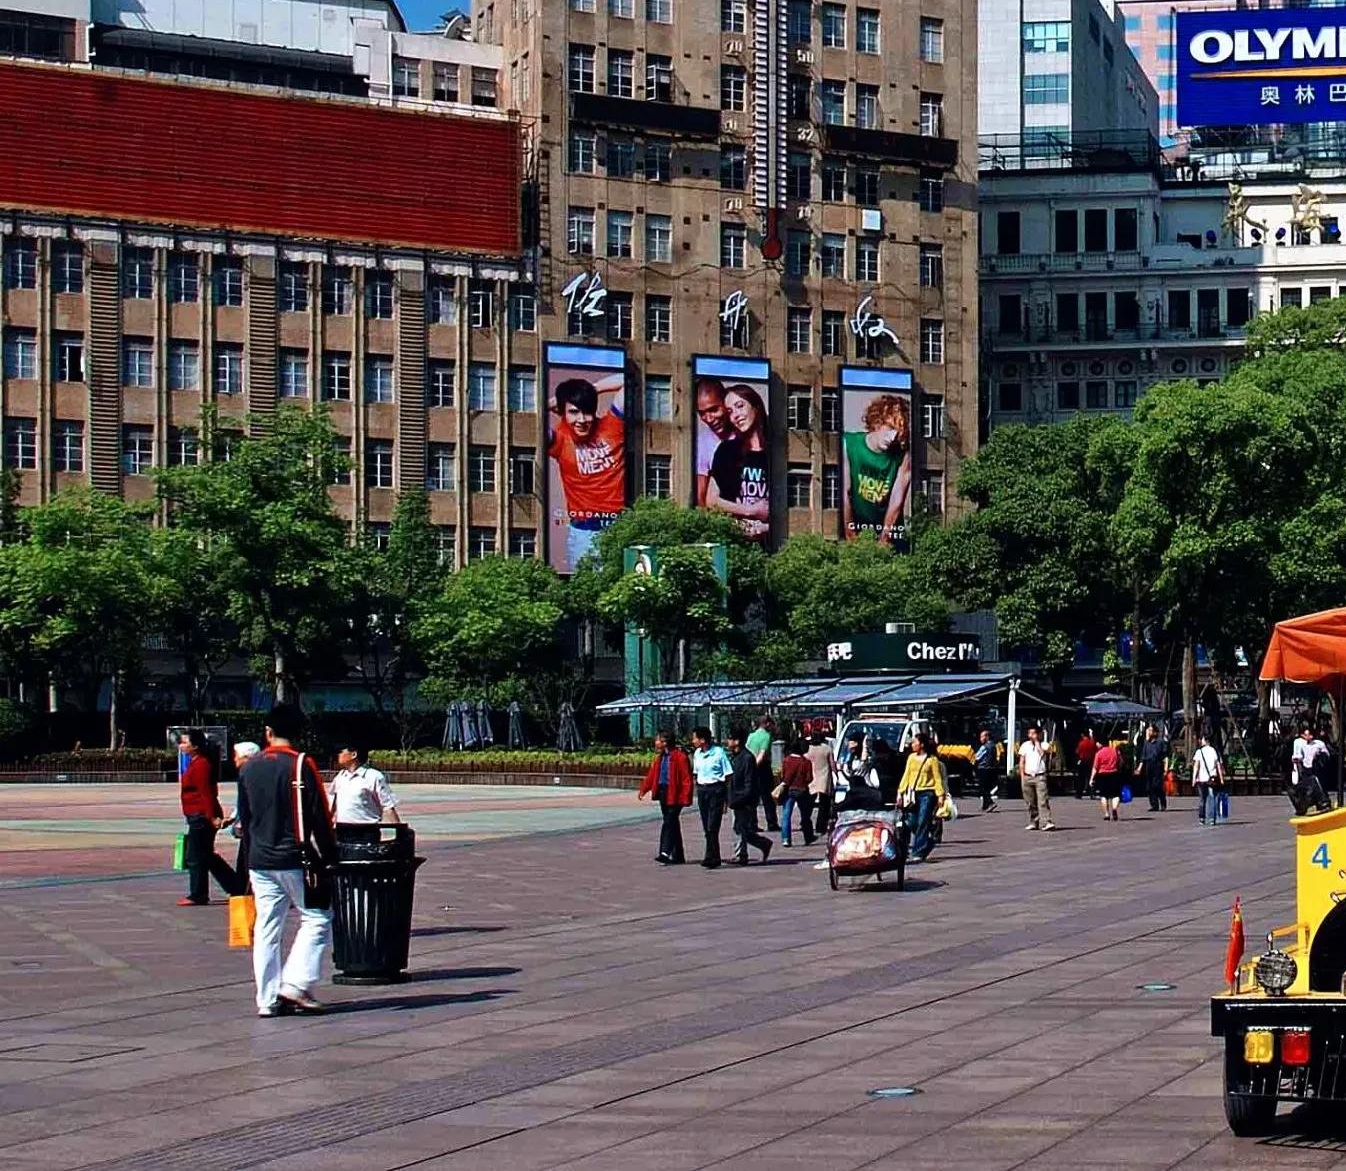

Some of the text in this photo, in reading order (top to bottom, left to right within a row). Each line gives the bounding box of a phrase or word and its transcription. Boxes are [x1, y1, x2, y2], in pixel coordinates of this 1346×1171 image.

[554, 510, 618, 519] GORDANO
[907, 641, 956, 660] Chez
[1311, 842, 1332, 869] 4
